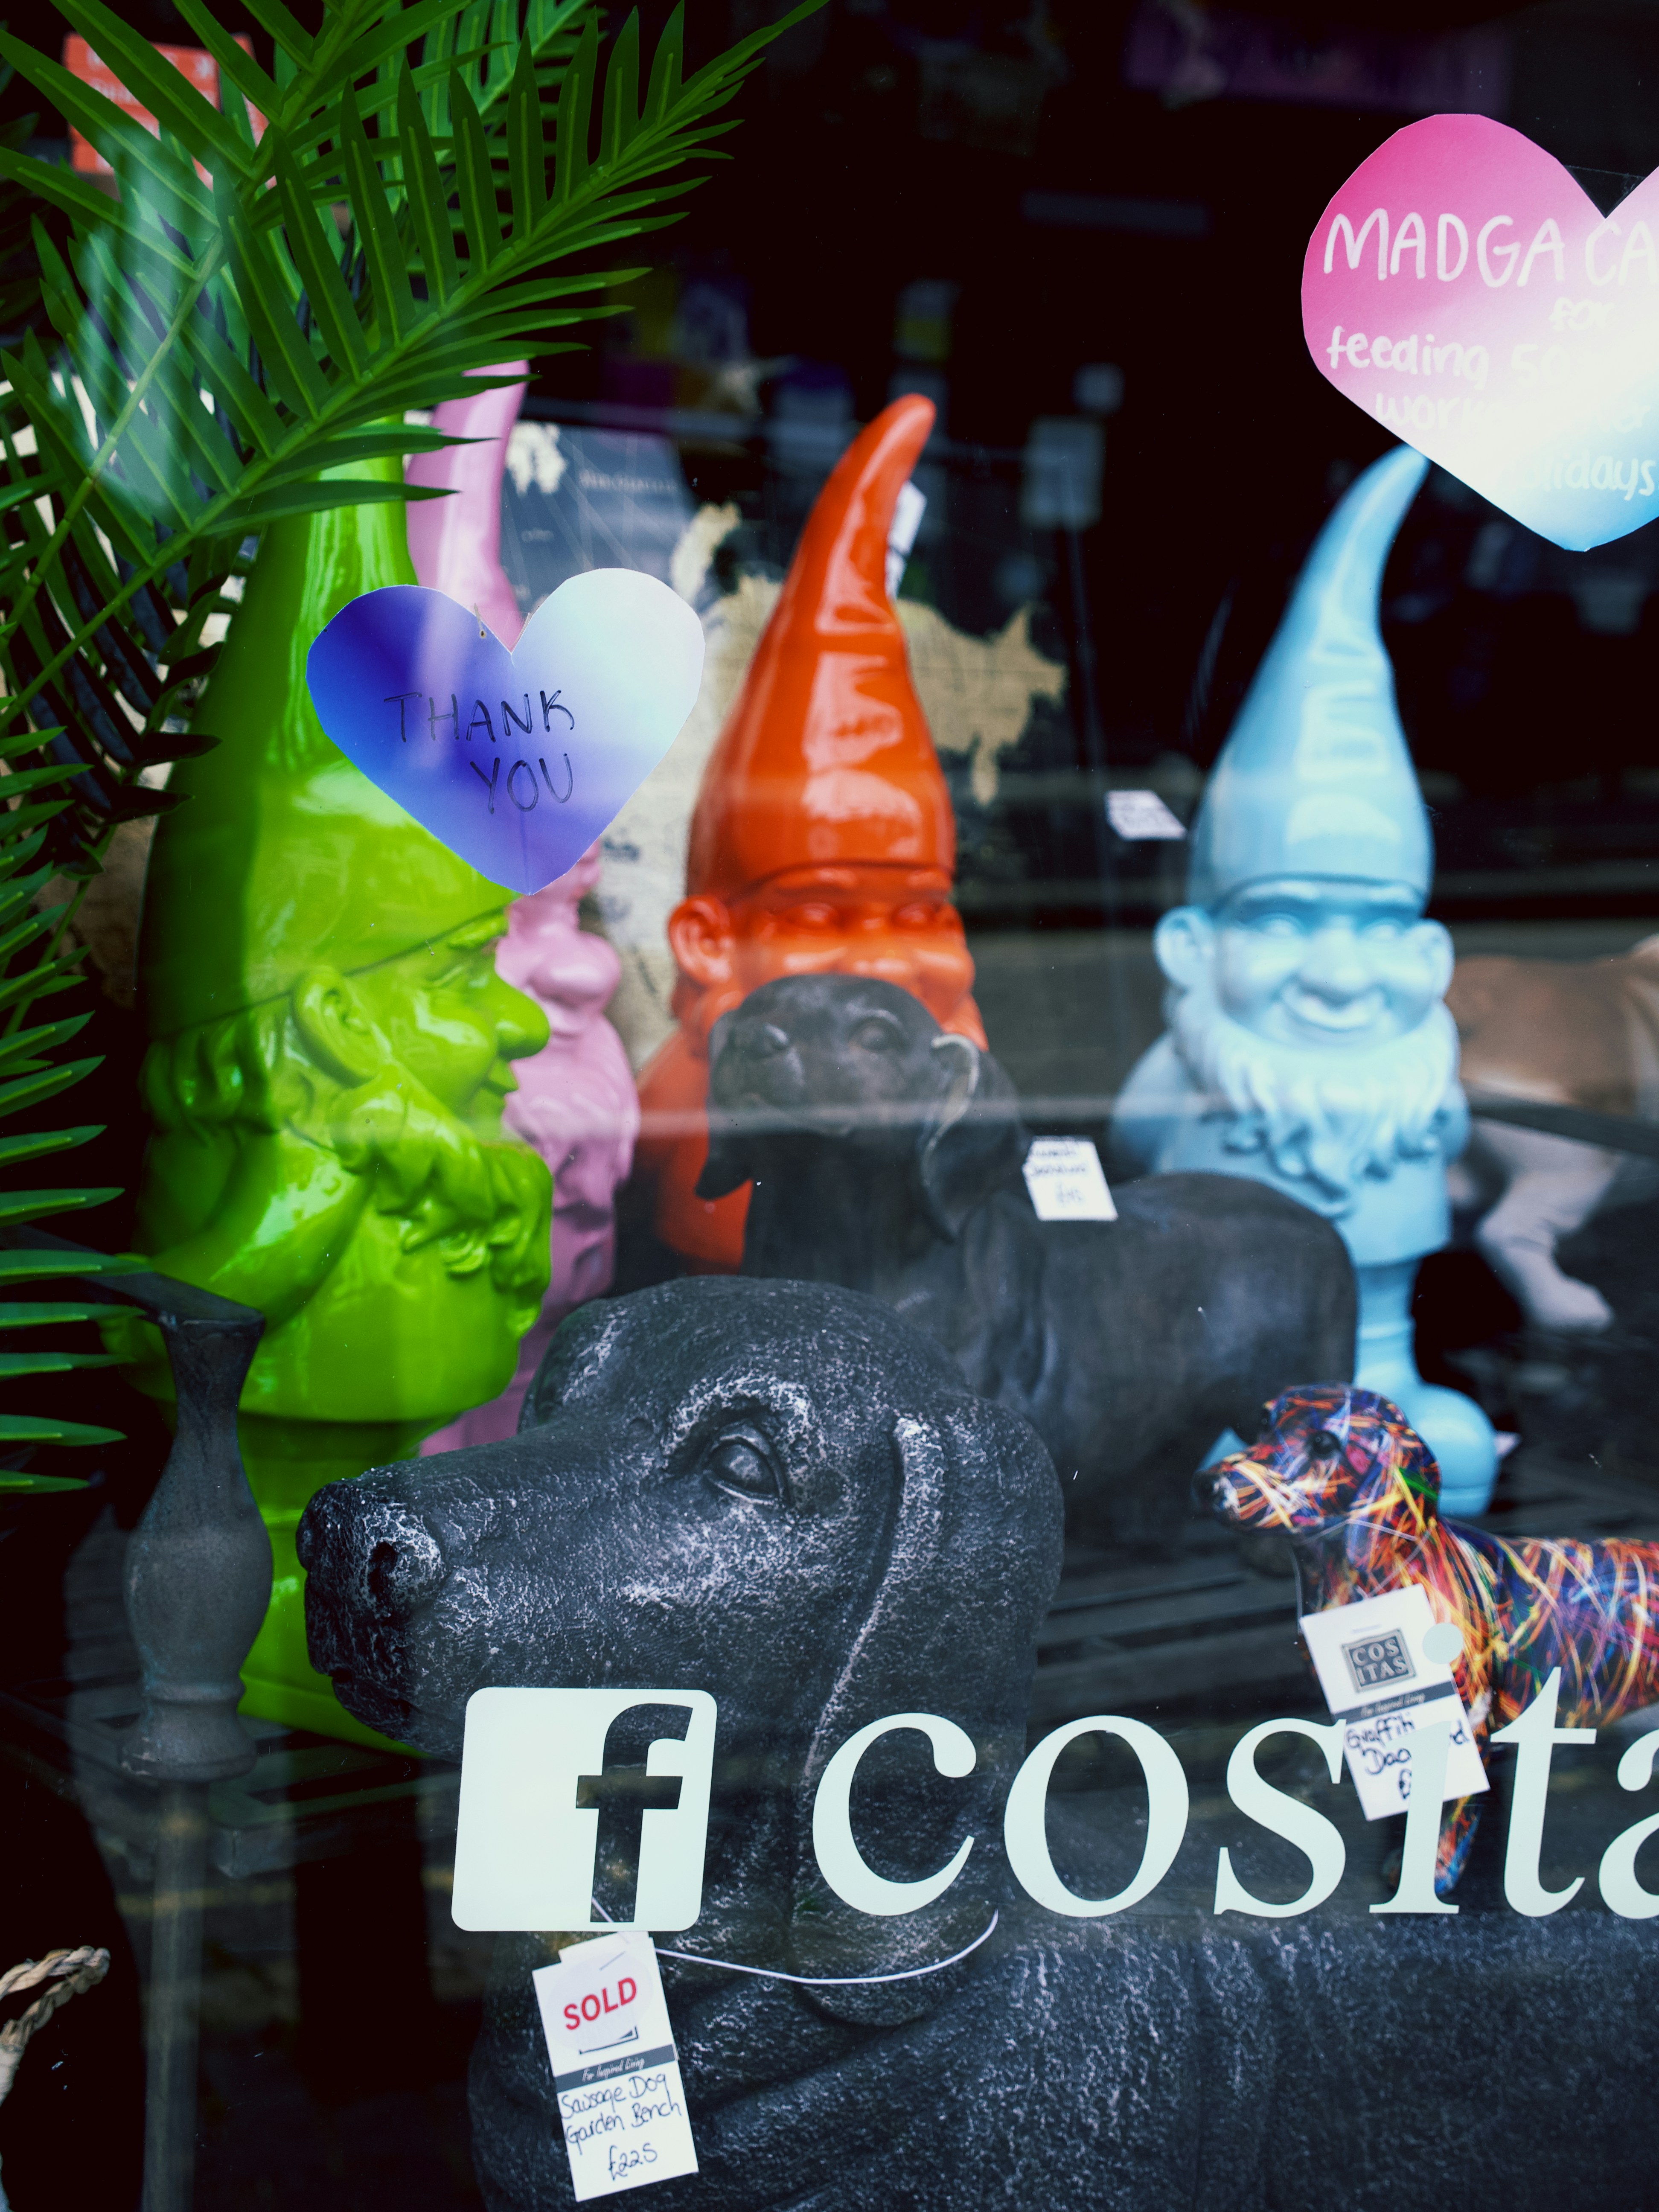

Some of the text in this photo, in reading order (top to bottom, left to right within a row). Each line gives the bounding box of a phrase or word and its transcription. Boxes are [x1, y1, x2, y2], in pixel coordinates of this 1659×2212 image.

[1323, 207, 1565, 288] MADGA
[1548, 297, 1615, 332] for
[1326, 326, 1489, 391] feeding
[383, 689, 575, 742] THANK
[470, 753, 573, 815] YOU
[1352, 1639, 1400, 1666] COS
[1356, 1656, 1408, 1684] ITAS
[563, 1976, 637, 2030] SOLD
[596, 2059, 624, 2080] Inspired
[561, 2073, 673, 2119] Sausage Dog
[566, 2101, 682, 2156] Garden Bench
[608, 2142, 658, 2182] £225
